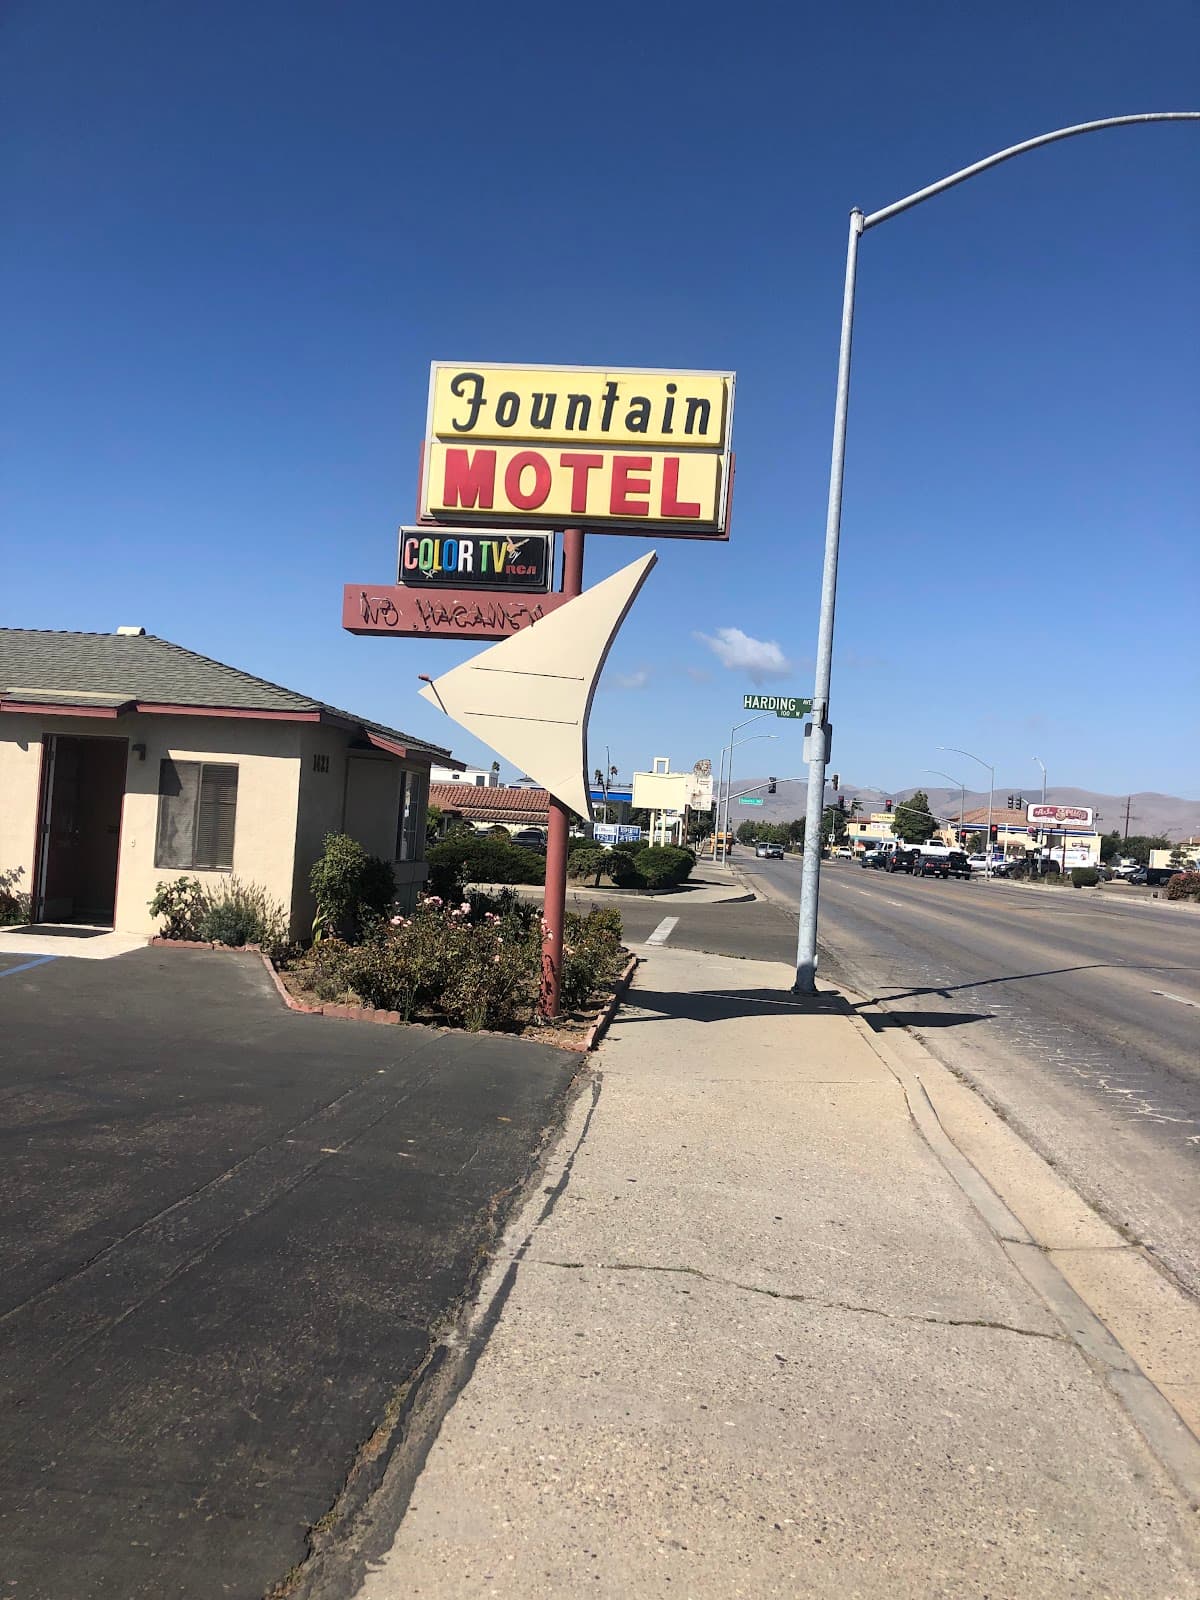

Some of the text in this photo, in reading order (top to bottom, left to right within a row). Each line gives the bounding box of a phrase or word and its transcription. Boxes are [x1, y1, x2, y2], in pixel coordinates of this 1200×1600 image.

[450, 372, 711, 435] Fountain
[443, 448, 701, 518] MOTEL
[404, 538, 508, 574] COLOR TV
[505, 564, 537, 575] RCA
[360, 591, 399, 627] NO
[744, 695, 796, 711] HARDING
